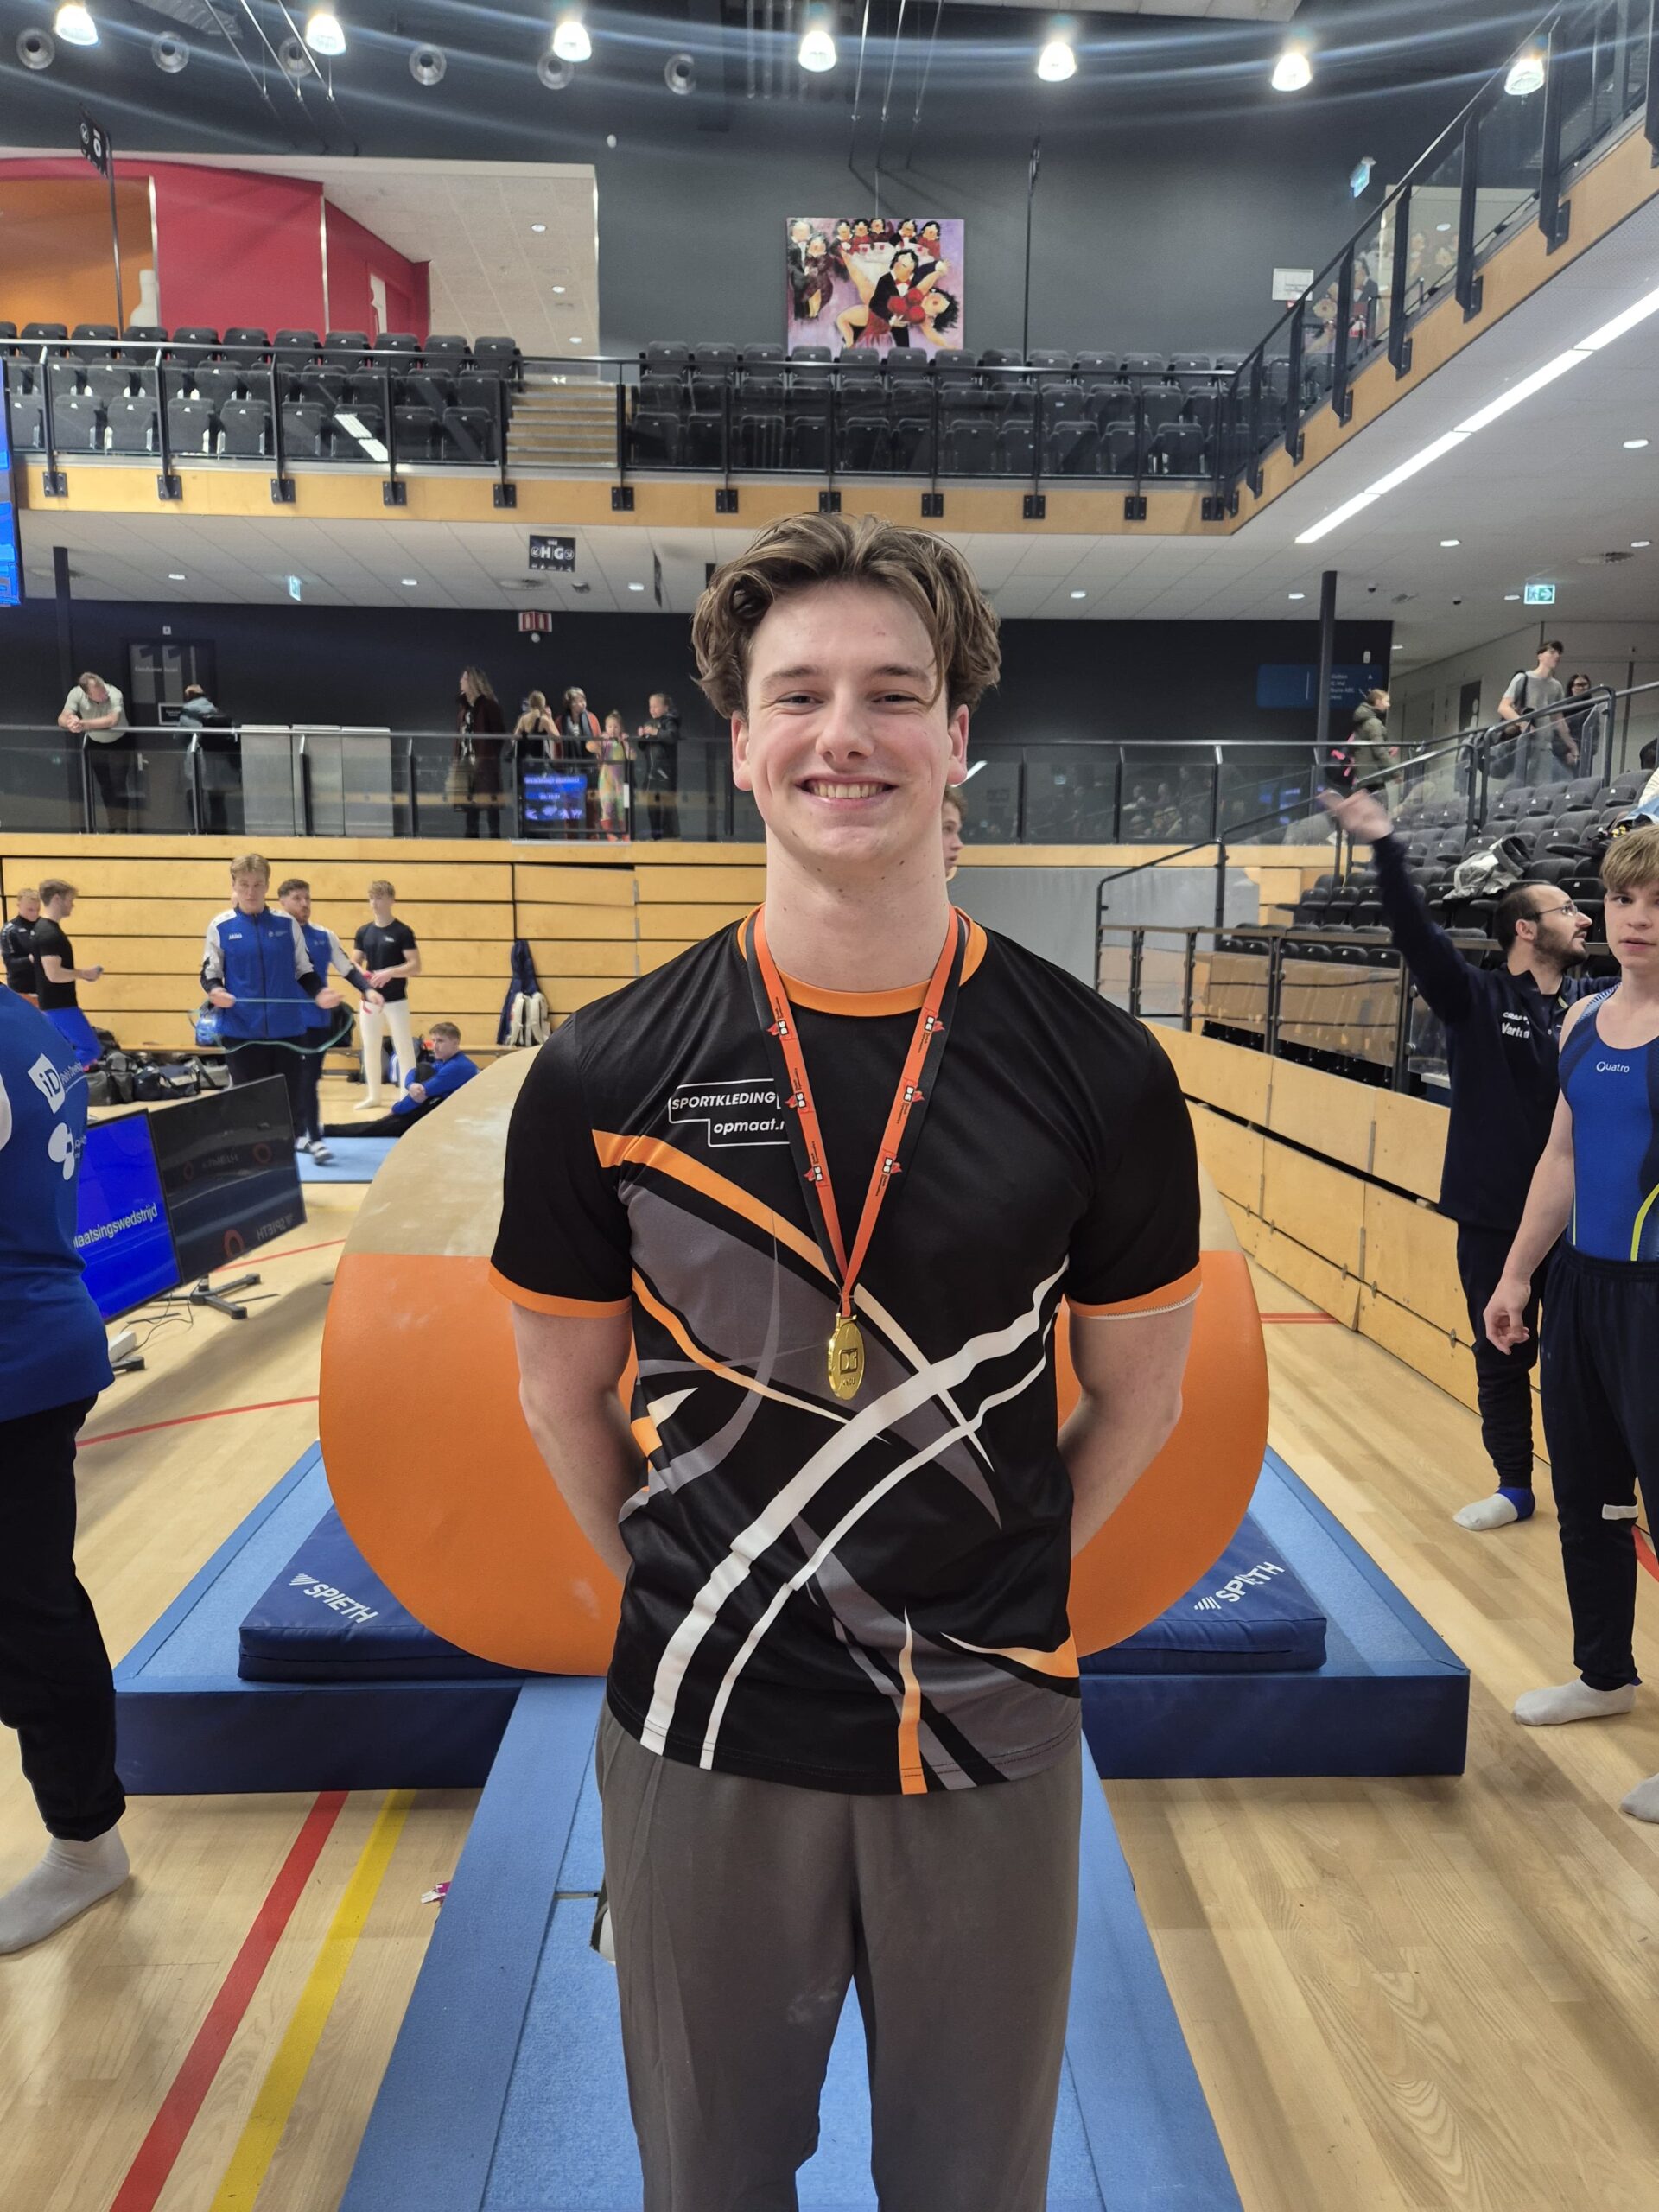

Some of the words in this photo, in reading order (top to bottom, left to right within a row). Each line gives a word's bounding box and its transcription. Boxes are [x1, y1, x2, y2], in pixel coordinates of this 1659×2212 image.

[1596, 1061, 1630, 1073] Quatro
[671, 1091, 776, 1110] SPORTKLEDING
[303, 1583, 379, 1624] SPIETH
